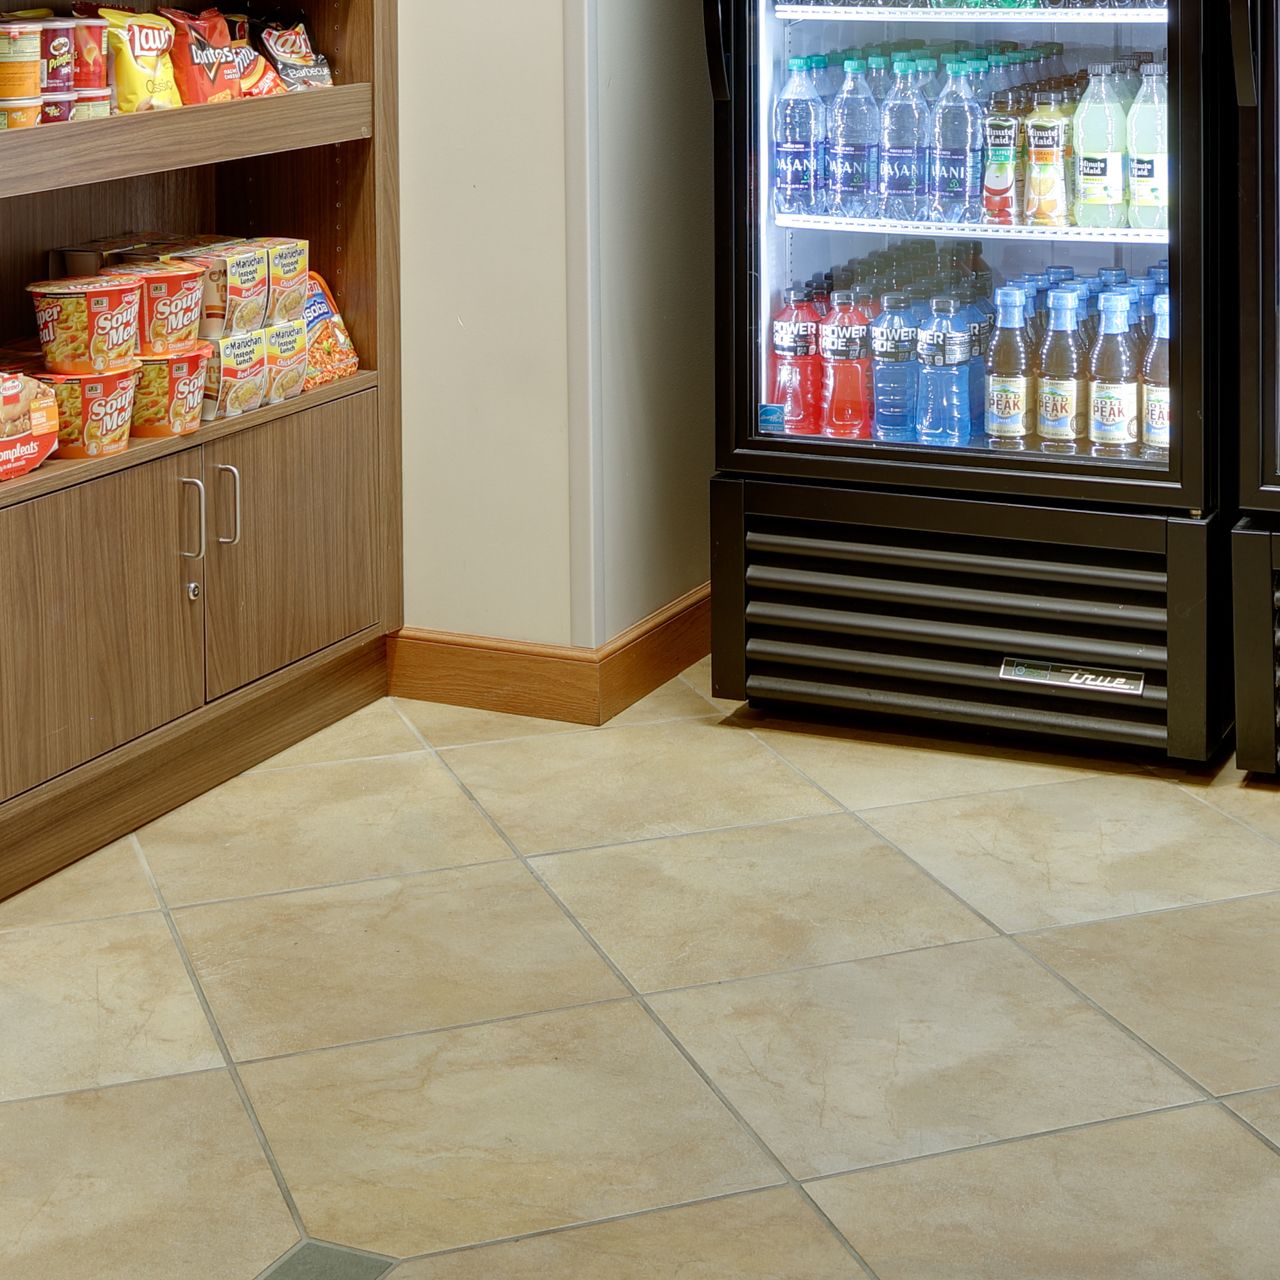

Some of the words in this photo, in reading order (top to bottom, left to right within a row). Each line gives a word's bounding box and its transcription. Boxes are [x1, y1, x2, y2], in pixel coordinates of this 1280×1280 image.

[192, 45, 233, 64] Doritos
[288, 67, 330, 78] Barbecue
[279, 249, 304, 260] Maruchan
[236, 256, 264, 269] Maruchan
[281, 259, 298, 268] Instant
[238, 268, 257, 277] Instant
[283, 267, 297, 275] Lunch
[240, 276, 256, 285] Lunch
[275, 327, 302, 339] Maruchan
[774, 322, 816, 335] POWER
[820, 326, 867, 338] POWER
[872, 328, 916, 340] POWER
[230, 337, 262, 350] Maruchan
[278, 337, 297, 347] Instant
[233, 348, 254, 359] Instant
[280, 345, 295, 353] Lunch
[236, 357, 253, 366] Lunch
[989, 399, 1021, 410] PEAK
[1039, 403, 1069, 414] PEAK
[1093, 406, 1125, 417] PEAK
